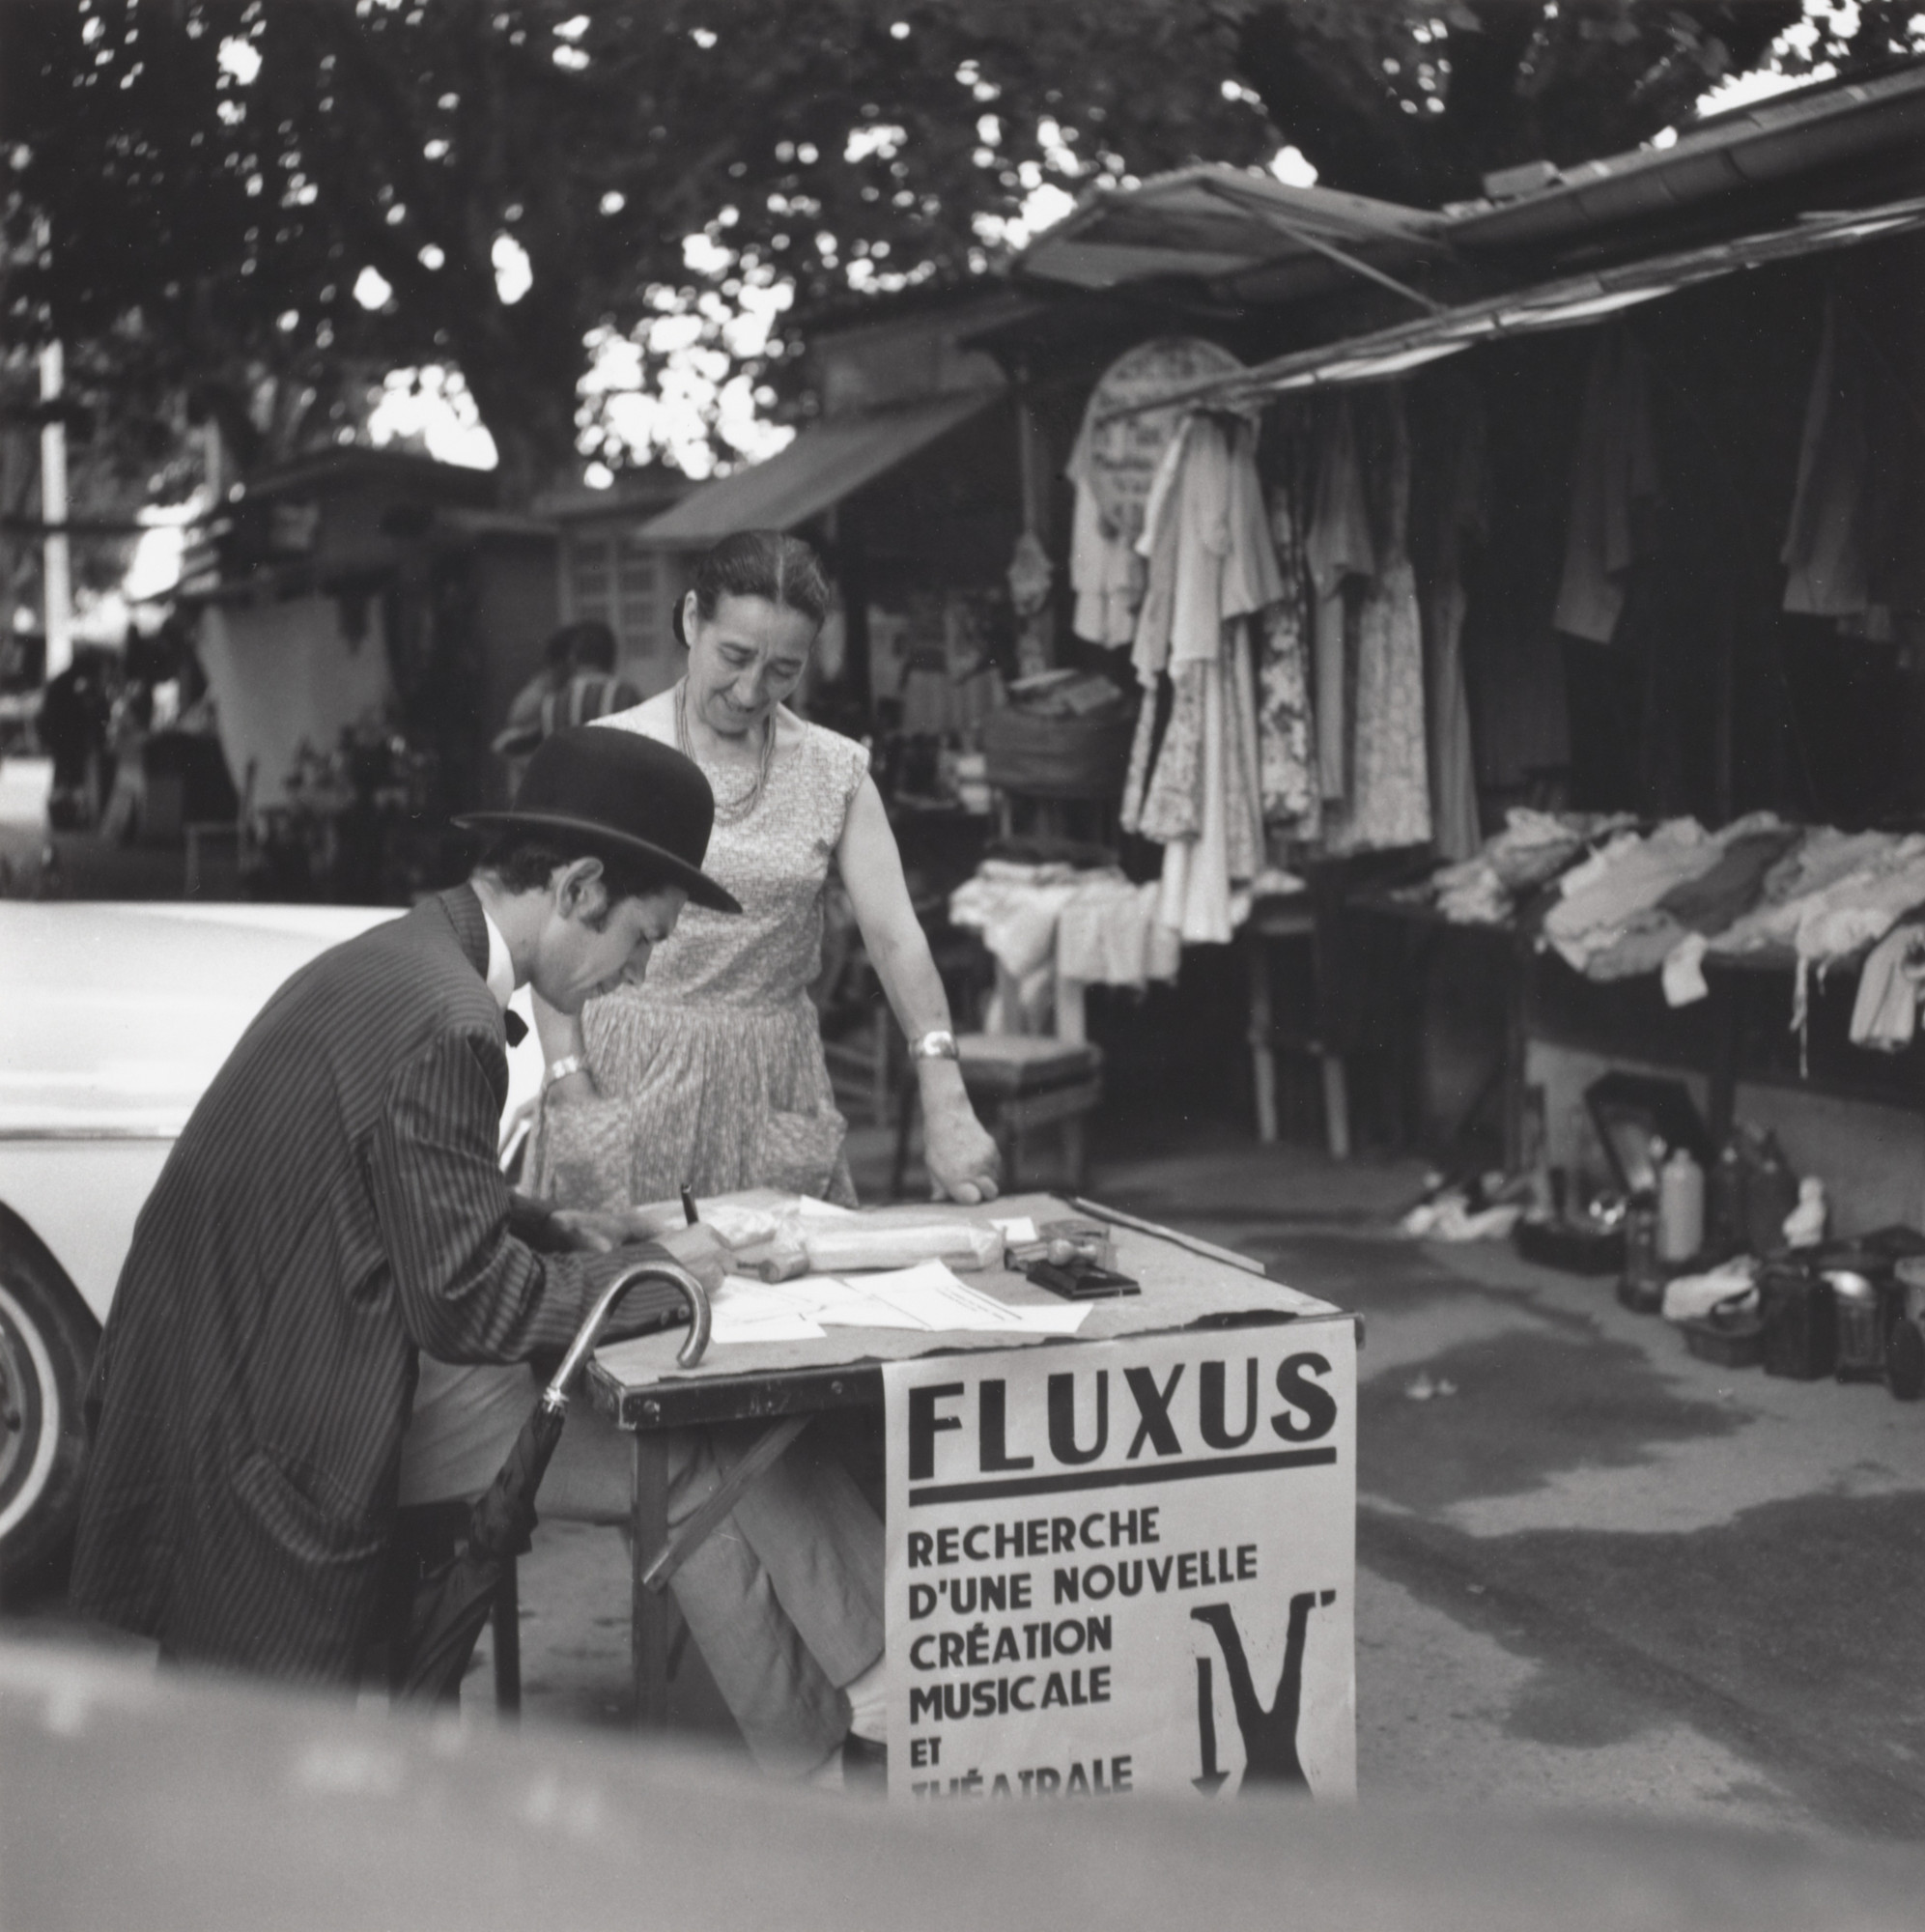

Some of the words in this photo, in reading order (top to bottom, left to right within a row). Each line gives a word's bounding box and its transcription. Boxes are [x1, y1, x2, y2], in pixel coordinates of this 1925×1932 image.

[908, 1351, 1338, 1481] FLUXUS
[907, 1506, 1160, 1569] RECHERCHE
[908, 1572, 1033, 1621] D'UNE
[1053, 1544, 1258, 1605] NOUVELLE
[909, 1613, 1113, 1671] CRÉATION
[909, 1664, 1112, 1725] MUSICALE
[910, 1736, 943, 1769] ET
